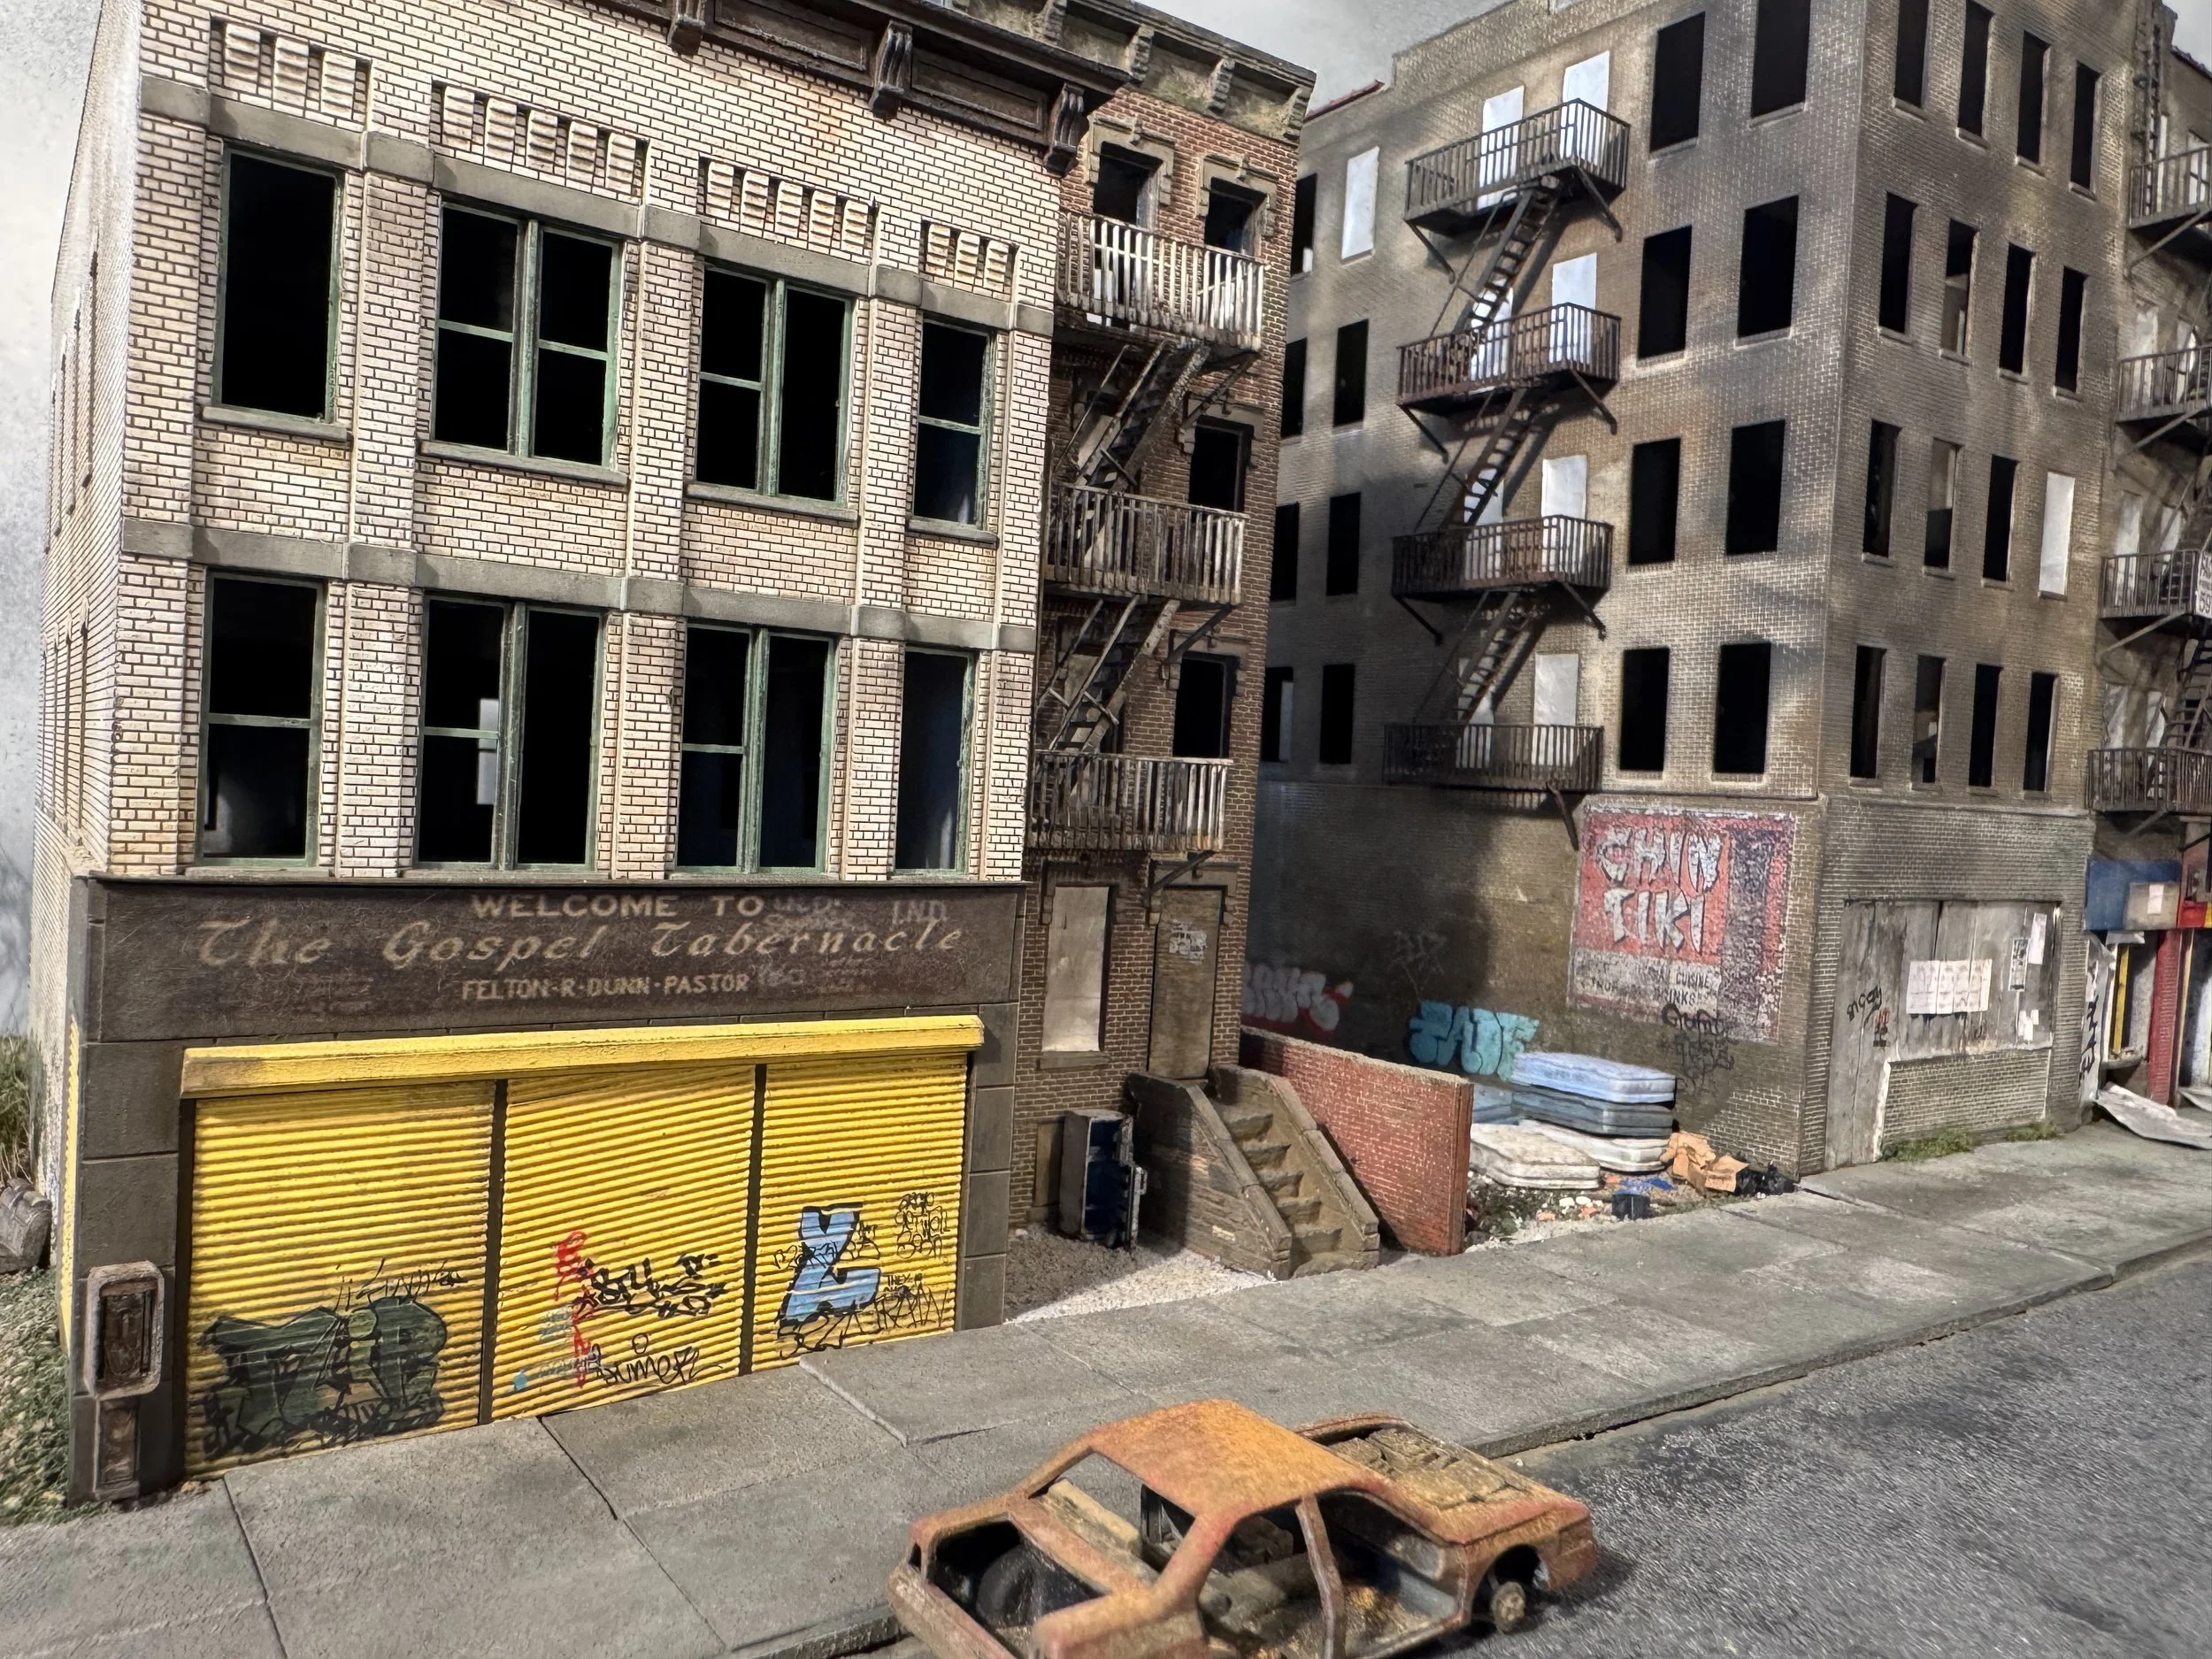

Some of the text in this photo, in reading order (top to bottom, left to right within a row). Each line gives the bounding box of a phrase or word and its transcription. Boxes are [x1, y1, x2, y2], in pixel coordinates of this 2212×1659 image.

[471, 895, 679, 918] WELCOME
[711, 895, 765, 918] TO
[1603, 887, 1706, 956] TIKI
[197, 913, 963, 972] The Gospel Tabernacle
[663, 973, 749, 995] PASTOR
